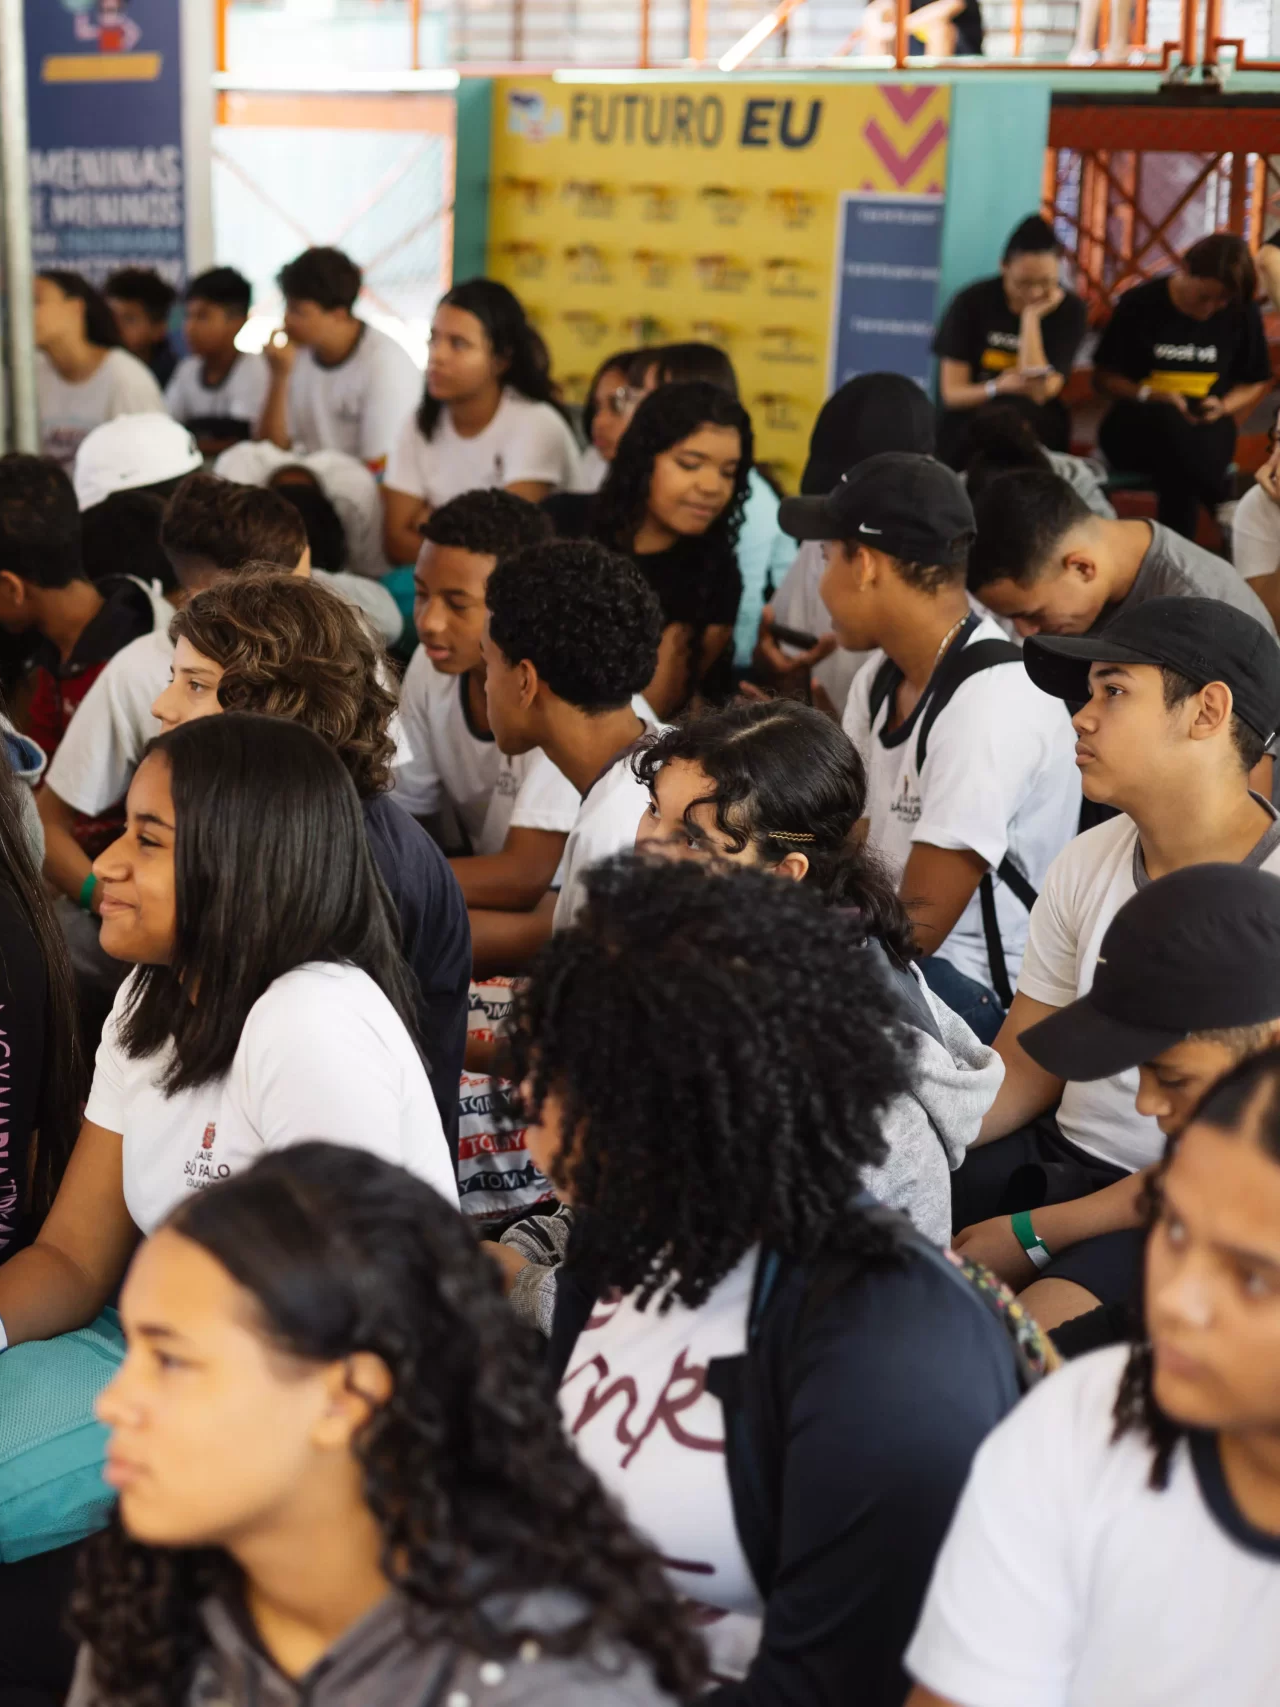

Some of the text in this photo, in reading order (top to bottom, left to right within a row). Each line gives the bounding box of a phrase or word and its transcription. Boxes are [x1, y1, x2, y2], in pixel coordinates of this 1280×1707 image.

[570, 93, 823, 148] FUTURO EU
[31, 145, 180, 188] MENINAS
[198, 1163, 231, 1180] PALO
